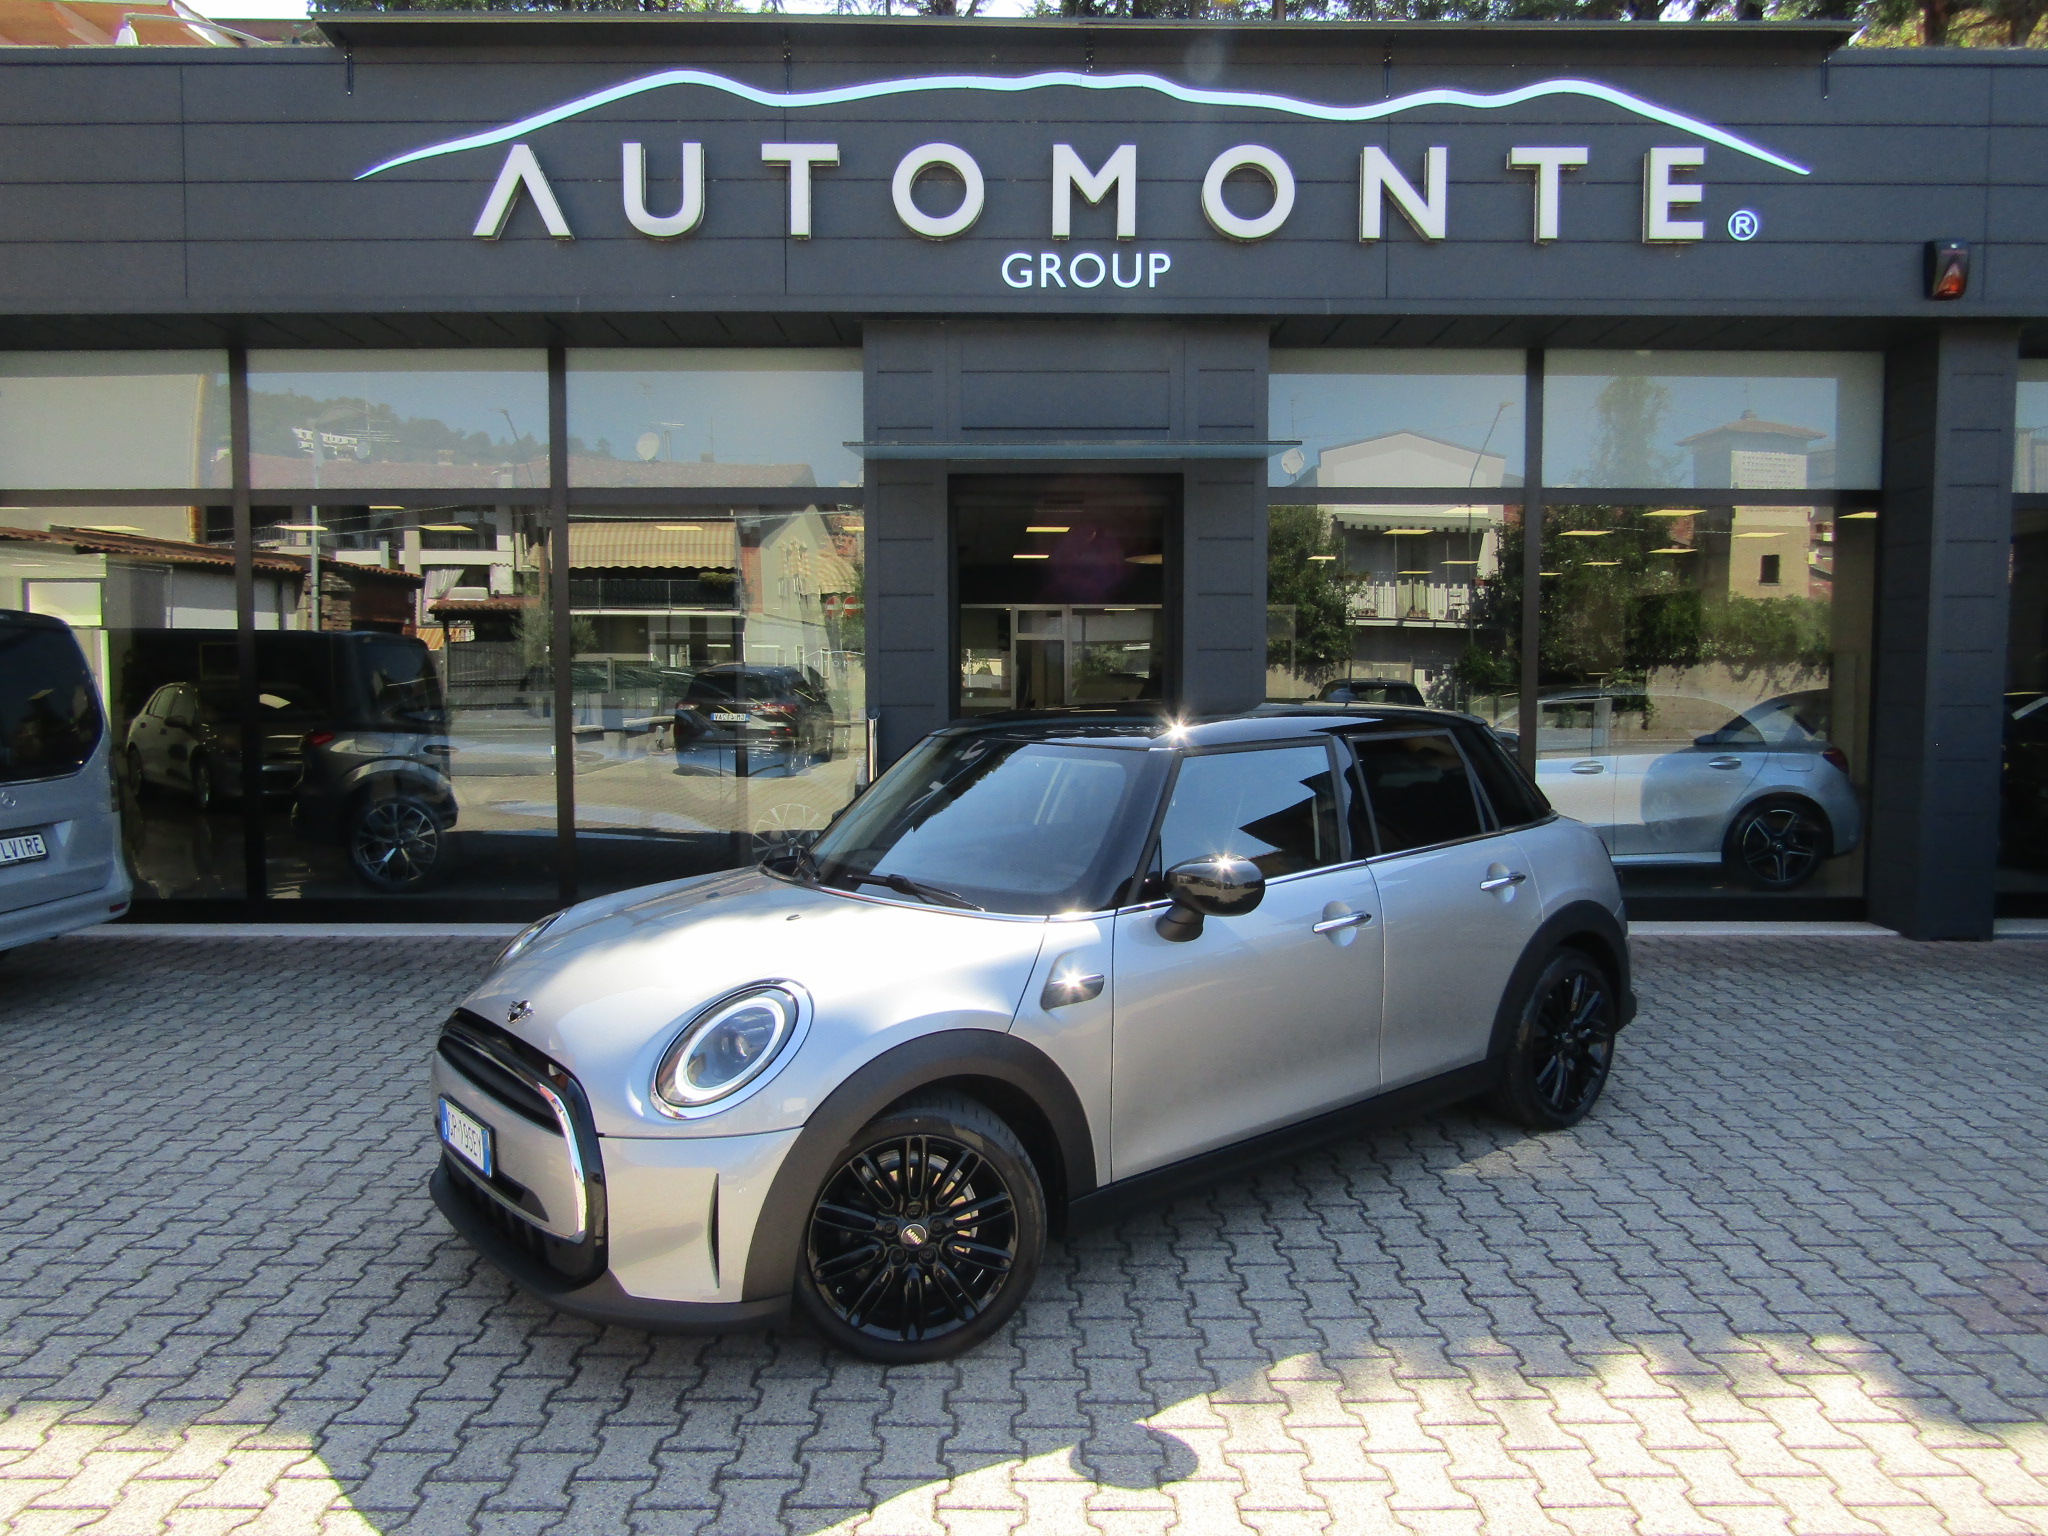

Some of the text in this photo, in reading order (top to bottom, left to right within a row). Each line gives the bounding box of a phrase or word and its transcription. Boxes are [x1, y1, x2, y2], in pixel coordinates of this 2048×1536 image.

[473, 142, 1706, 243] AUTOMONTE
[1001, 252, 1171, 289] GROUP
[906, 1228, 922, 1245] MINI
